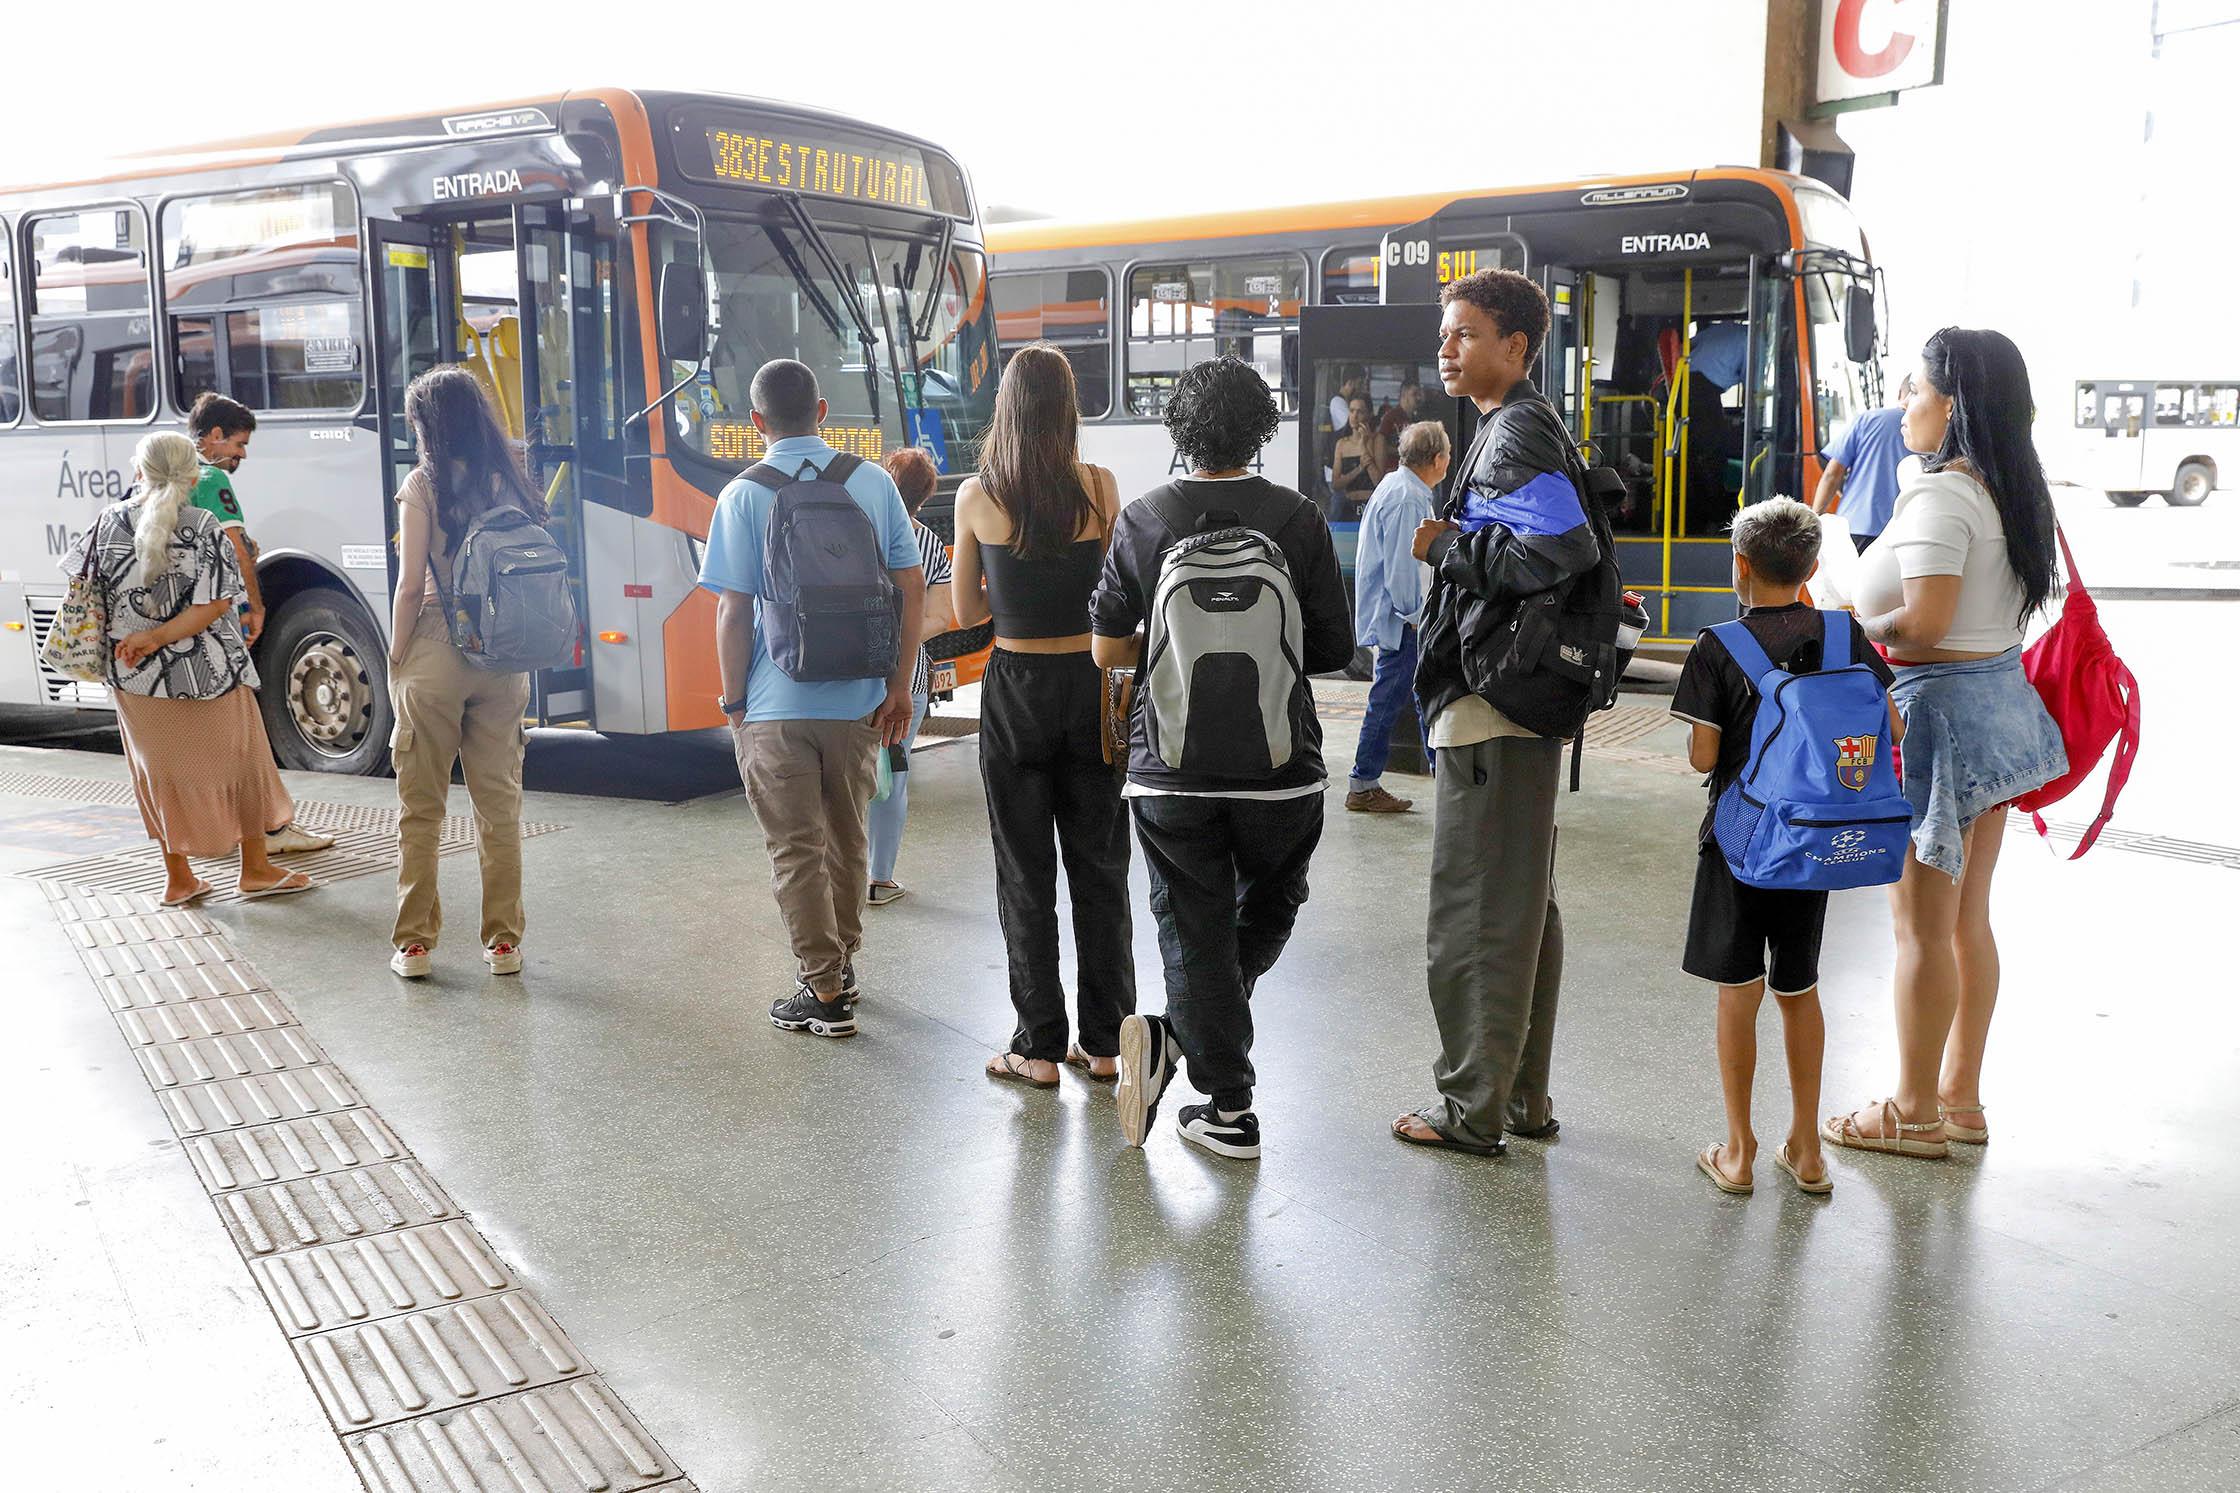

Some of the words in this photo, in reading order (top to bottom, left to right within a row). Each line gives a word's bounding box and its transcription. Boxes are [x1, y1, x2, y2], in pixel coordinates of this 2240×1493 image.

[1834, 0, 1916, 79] C
[432, 168, 523, 200] ENTRADA
[1387, 242, 1401, 267] C
[1404, 240, 1430, 266] 09
[1621, 232, 1711, 254] ENTRADA
[711, 424, 766, 460] SOME
[818, 427, 882, 460] ARTAO
[57, 449, 123, 498] Área
[218, 488, 239, 515] 9
[1851, 758, 1868, 766] FCB
[1804, 847, 1888, 862] CHAMPIONS
